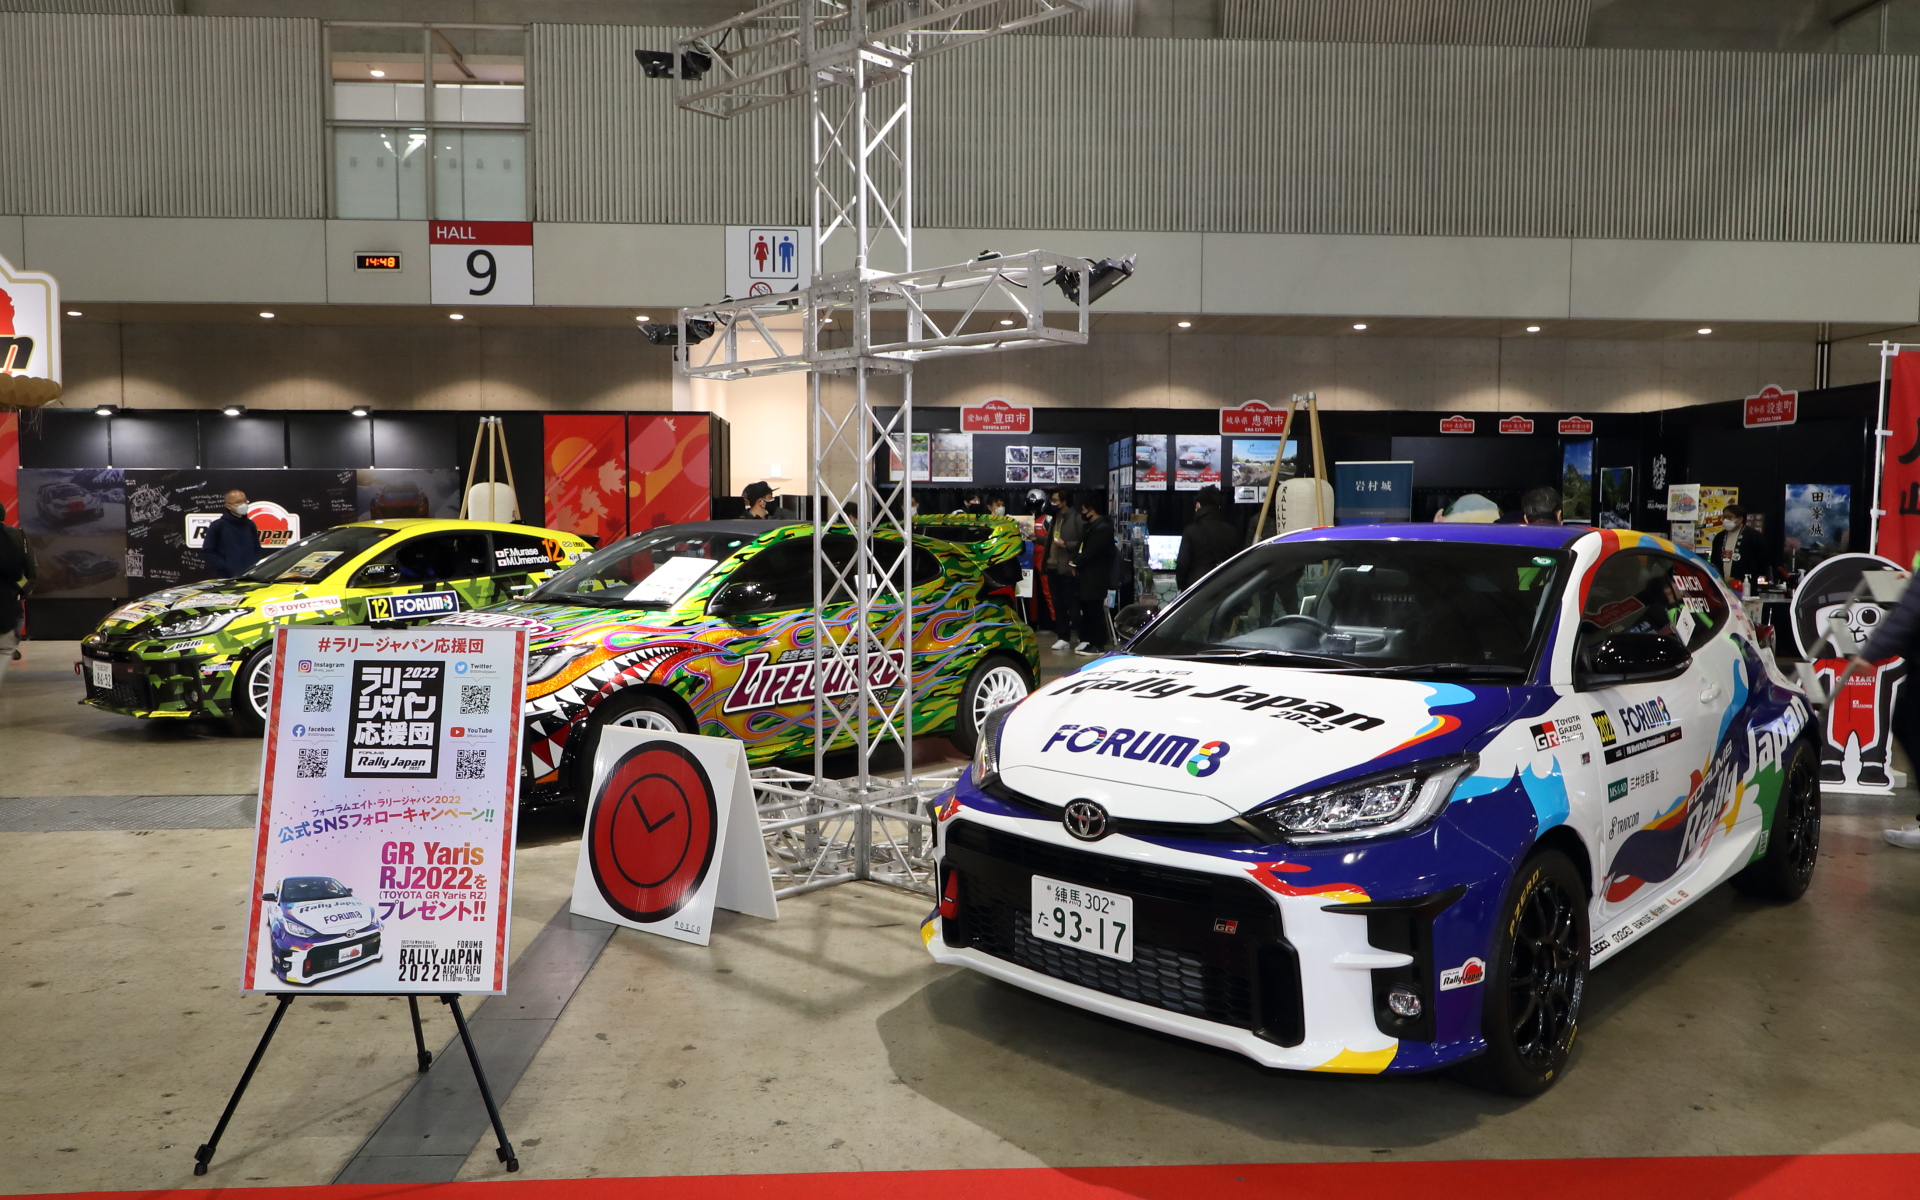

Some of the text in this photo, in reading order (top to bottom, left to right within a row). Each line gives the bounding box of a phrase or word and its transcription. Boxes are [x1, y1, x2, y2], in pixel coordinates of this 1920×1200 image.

[436, 226, 476, 240] HALL
[365, 257, 396, 268] 14:48
[465, 249, 498, 297] 9
[967, 411, 1027, 425] 愛知県 豊田市
[1226, 414, 1284, 428] 岐阜県 恵那市
[1355, 480, 1392, 492] 岩村城
[1810, 491, 1825, 537] 田峯城
[259, 529, 293, 543] apan
[503, 547, 539, 558] F.Murase
[541, 538, 564, 562] 12
[506, 554, 550, 567] M.Umemoto
[1682, 575, 1703, 591] AICHI
[372, 594, 454, 620] 12 FORUM8
[1692, 597, 1710, 613] GIFU
[318, 637, 484, 654] #ラリージャパン応援団
[313, 661, 345, 669] Instagram
[403, 666, 439, 679] 2022
[361, 667, 422, 696] ラリー
[358, 691, 436, 720] ジャパン
[1047, 677, 1386, 732] Rally Japan
[1269, 710, 1336, 734] 2022
[1554, 715, 1581, 726] TOYOTA
[1593, 696, 1672, 743] 2022 FORUM8
[354, 720, 435, 746] 応援団
[1558, 723, 1582, 735] GAZOO
[1535, 731, 1560, 751] GR
[1561, 732, 1585, 745] Racing
[1041, 724, 1231, 778] FORUM8
[358, 756, 426, 769] Rally Japan
[1630, 768, 1660, 791] 三井住友海上
[1676, 695, 1810, 868] Rally Japan
[1687, 740, 1733, 815] FORUM8
[311, 795, 461, 818] フォーラムエイト・ラリージャパン2022
[278, 807, 495, 844] 公式SNSフォローキャンペーン!!
[381, 841, 485, 865] GR Yaris
[380, 866, 488, 890] RJ2022を
[379, 890, 487, 900] (TOYOTA GR Yaris RZ)
[1055, 886, 1110, 914] 練馬 302
[323, 910, 363, 925] FORUM8
[378, 899, 487, 922] プレゼント!!
[1038, 906, 1127, 954] た 93-17
[1215, 923, 1235, 934] GR
[457, 940, 483, 949] FORUM8
[399, 949, 483, 965] RALLY JAPAN
[398, 964, 441, 982] 2022
[442, 965, 482, 975] AICHI/GIFU
[1443, 971, 1484, 986] Rally Japan
